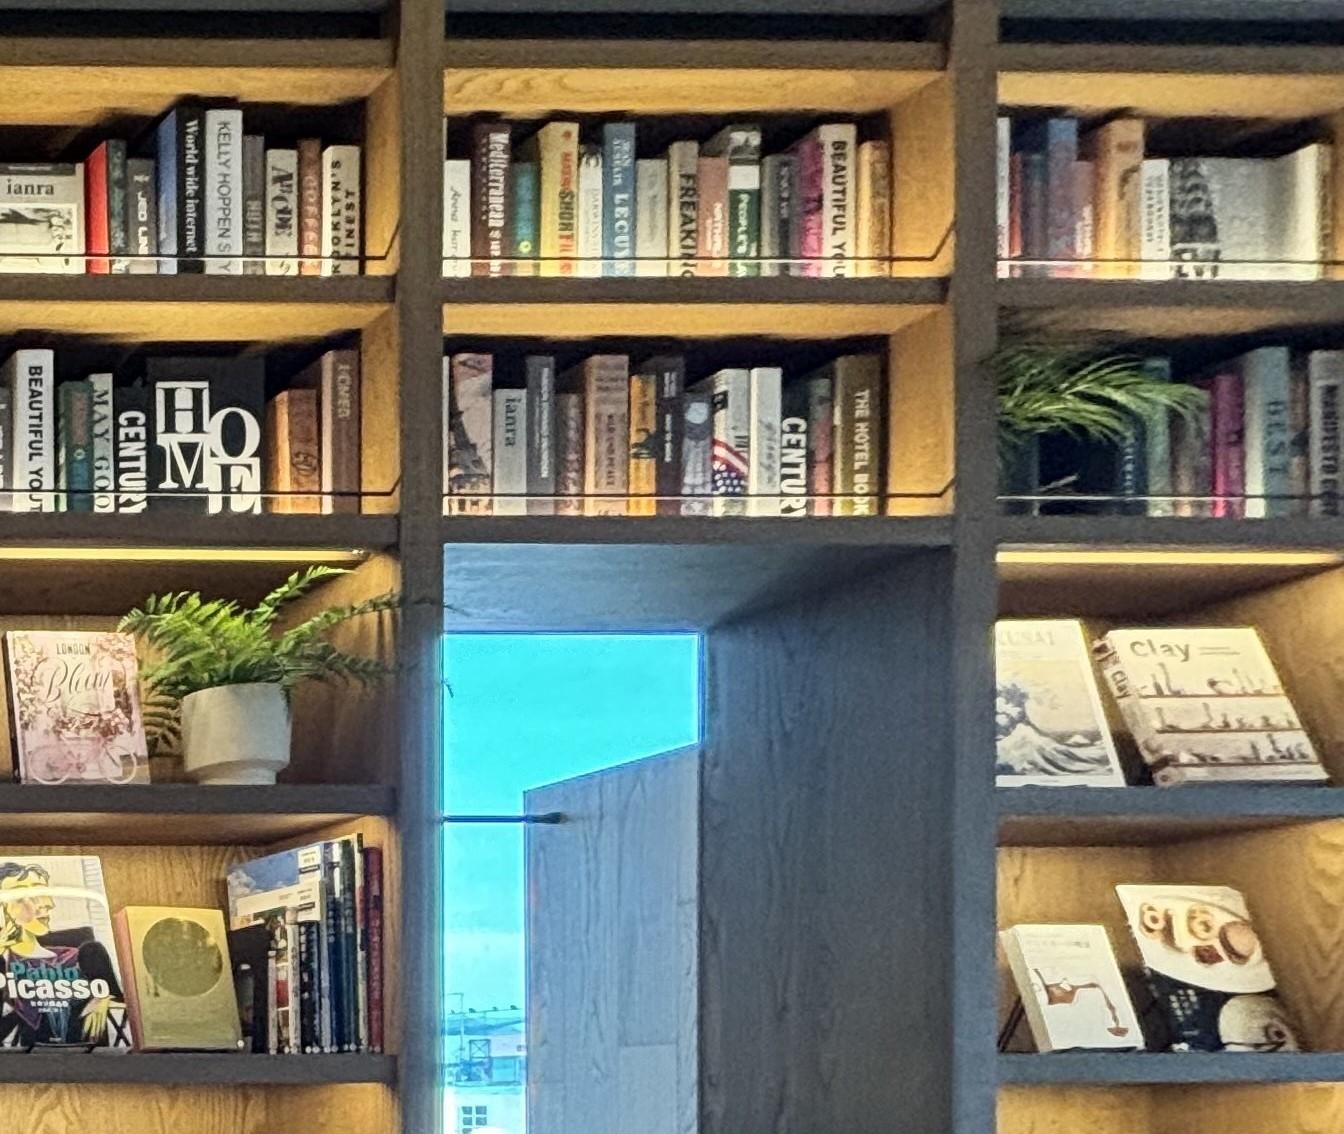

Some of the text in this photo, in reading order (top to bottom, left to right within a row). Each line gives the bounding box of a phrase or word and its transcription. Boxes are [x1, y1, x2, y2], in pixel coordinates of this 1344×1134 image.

[184, 119, 200, 164] World
[6, 178, 55, 196] ianra
[184, 166, 200, 198] wide
[216, 120, 232, 239] KELLY HOPPEN
[831, 140, 847, 236] BEAUTIFUL
[28, 365, 44, 463] BEAUTIFUL
[93, 389, 110, 444] MAY
[504, 397, 524, 448] ianra
[853, 390, 870, 419] THE
[853, 422, 870, 470] HOTEL
[1129, 639, 1192, 663] Clay
